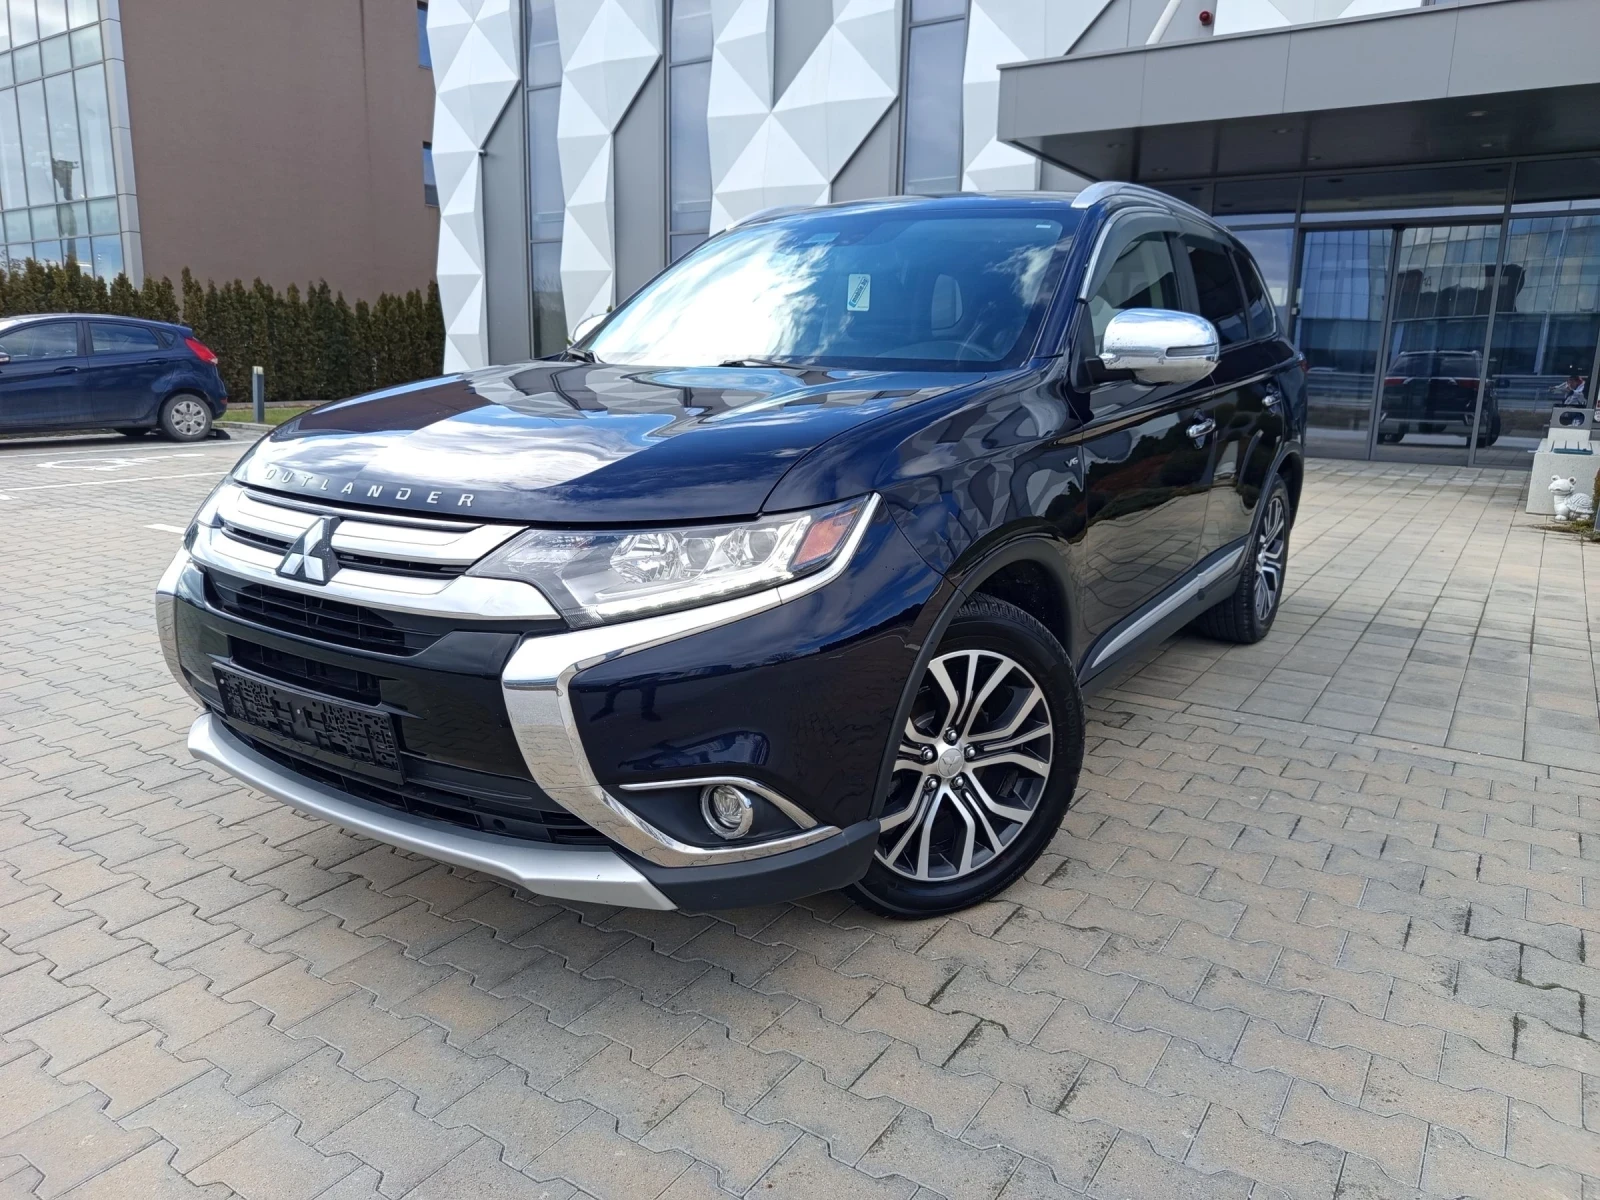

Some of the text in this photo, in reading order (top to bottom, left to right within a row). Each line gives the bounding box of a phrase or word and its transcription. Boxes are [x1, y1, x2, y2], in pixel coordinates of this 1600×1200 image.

[1065, 457, 1079, 467] V6
[264, 467, 476, 507] OUTLANDER
[1064, 692, 1077, 767] YOKOH
